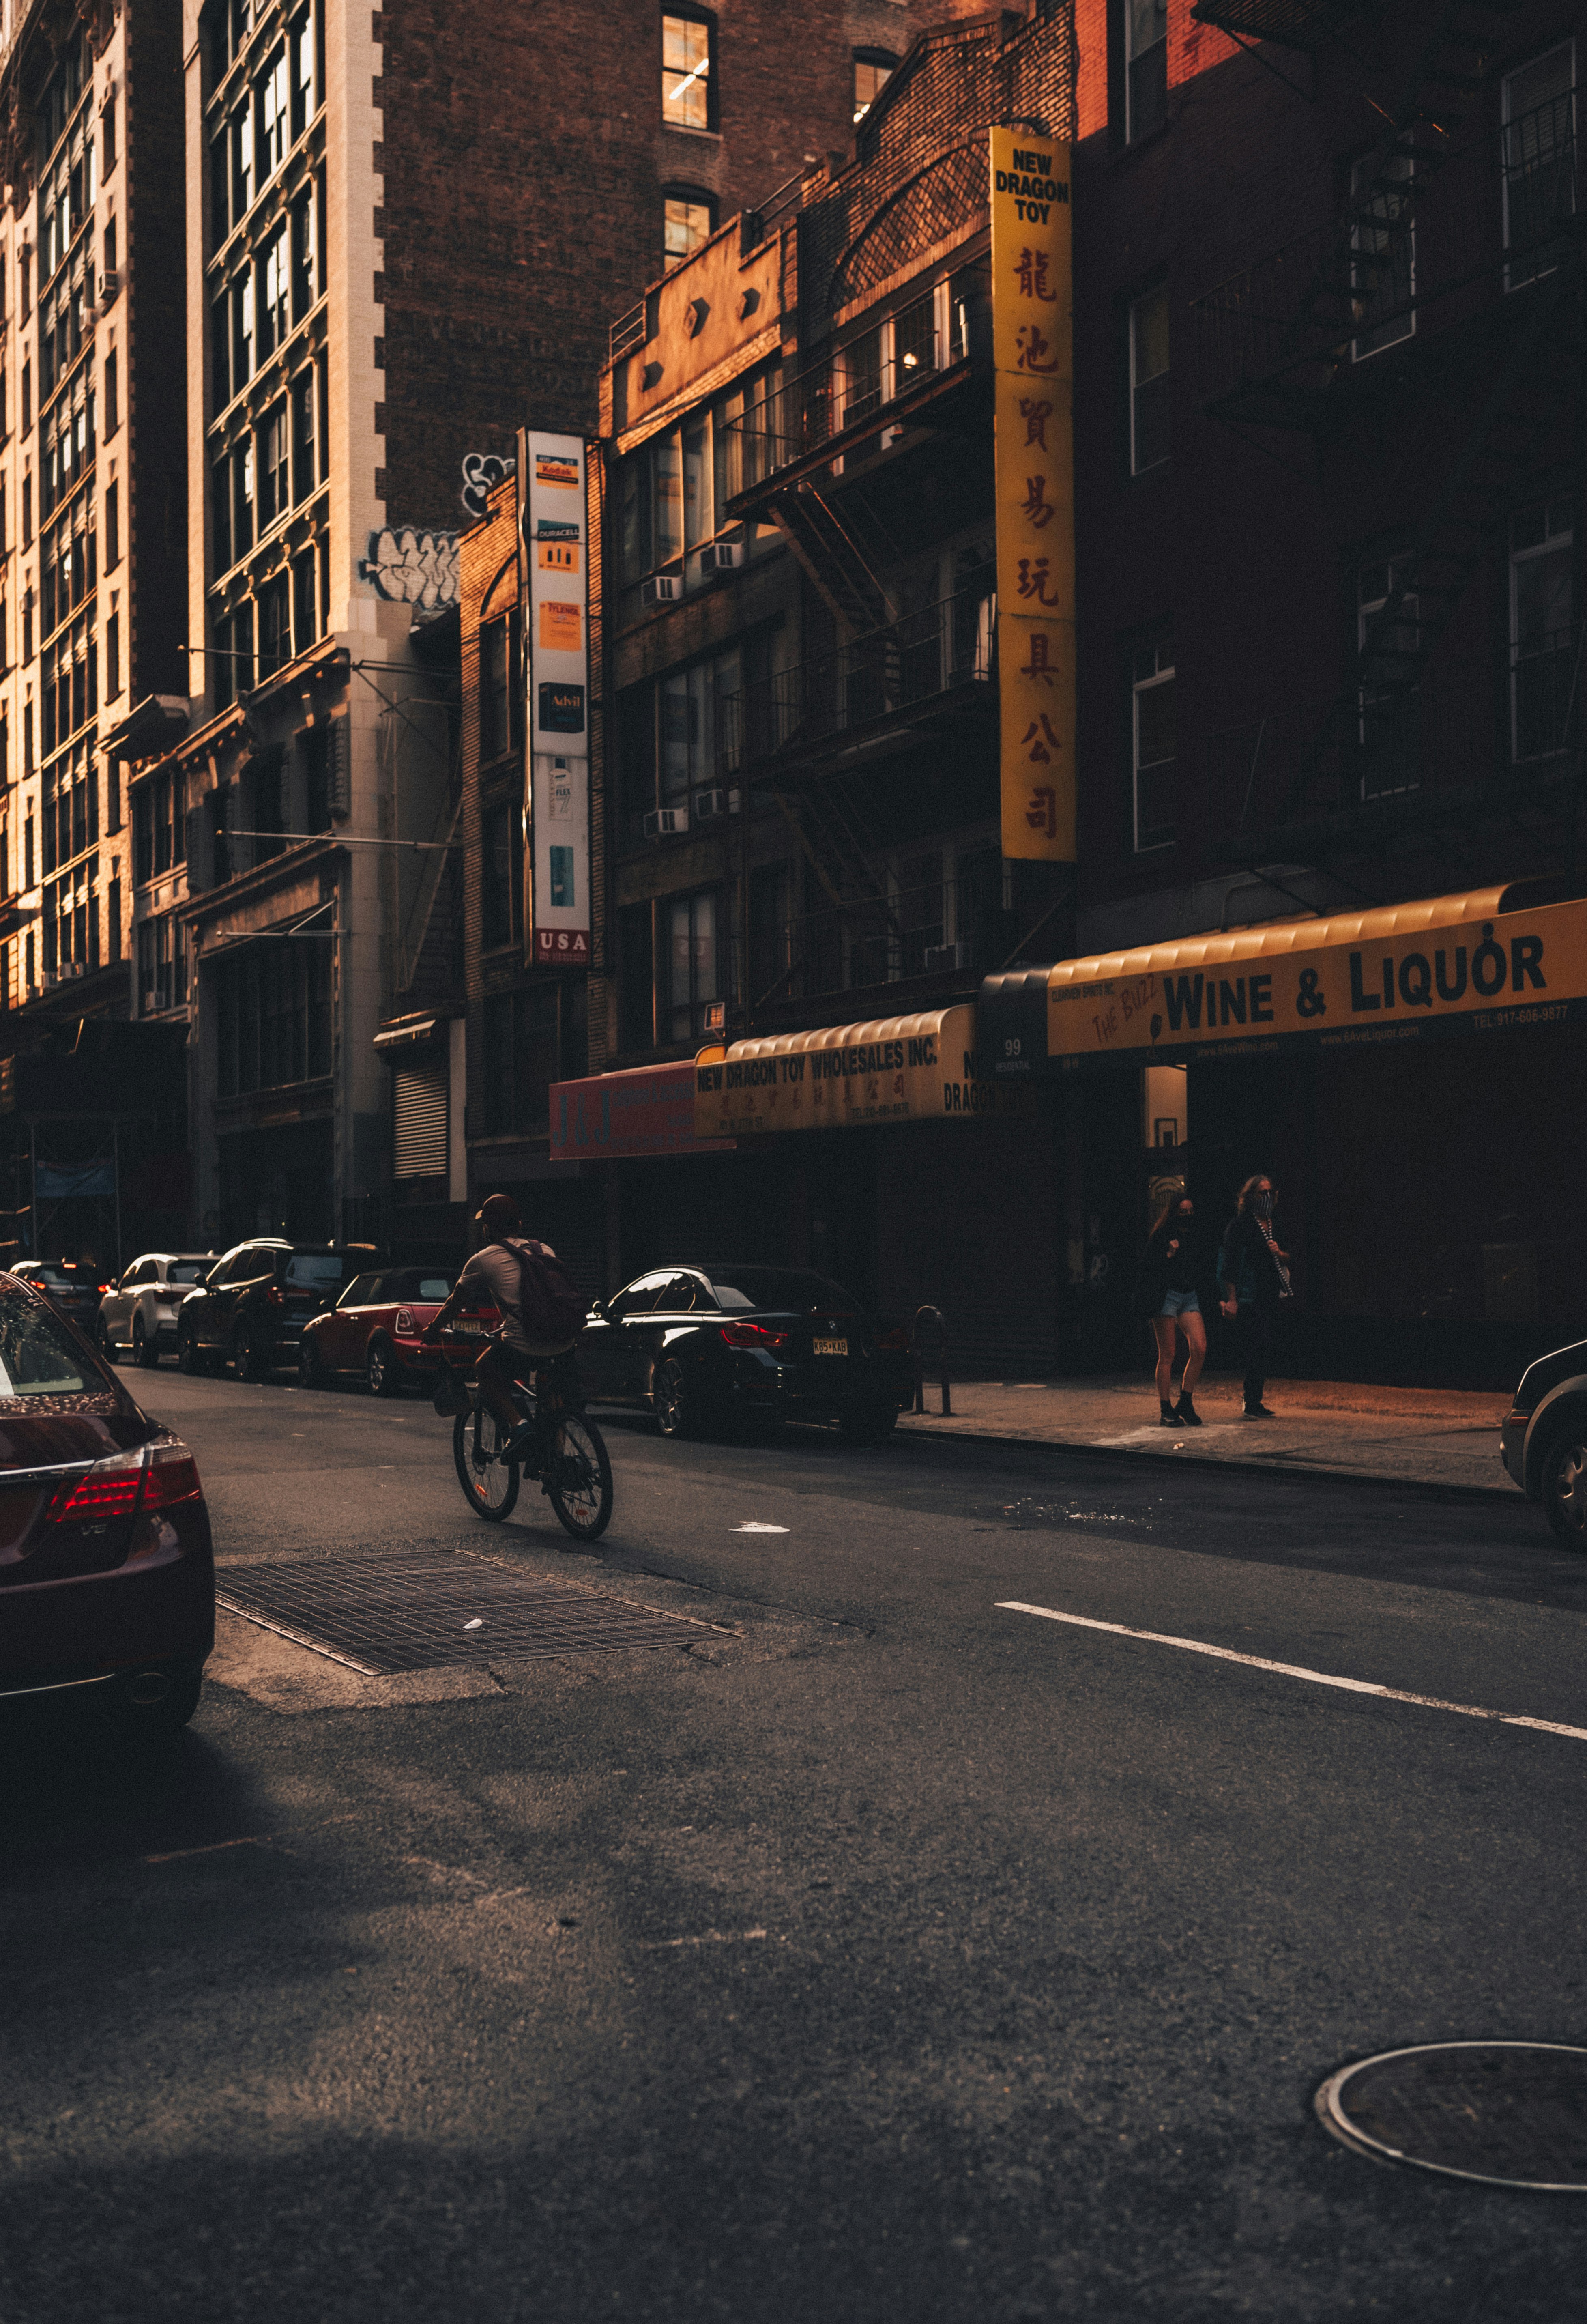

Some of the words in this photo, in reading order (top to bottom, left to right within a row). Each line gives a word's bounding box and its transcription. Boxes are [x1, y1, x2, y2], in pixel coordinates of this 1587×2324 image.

[1012, 148, 1052, 176] NEW
[996, 170, 1069, 204] DRAGON
[1015, 199, 1050, 225] TOY
[542, 465, 572, 476] Kodak
[539, 529, 579, 537] DURACELL
[1012, 247, 1061, 839] 龍池貿易玩具公司
[551, 695, 580, 707] Advil
[540, 932, 587, 951] USA
[1092, 1006, 1118, 1042] THE
[1120, 972, 1158, 1021] BUZZ
[1163, 974, 1273, 1031] WINE
[1296, 967, 1326, 1017] &
[1005, 1038, 1021, 1056] 99
[697, 1066, 723, 1092] NEW
[726, 1057, 778, 1089] DRAGON
[780, 1055, 806, 1083] TOY
[812, 1041, 904, 1080] WHOLESALES
[908, 1037, 938, 1067] INC.
